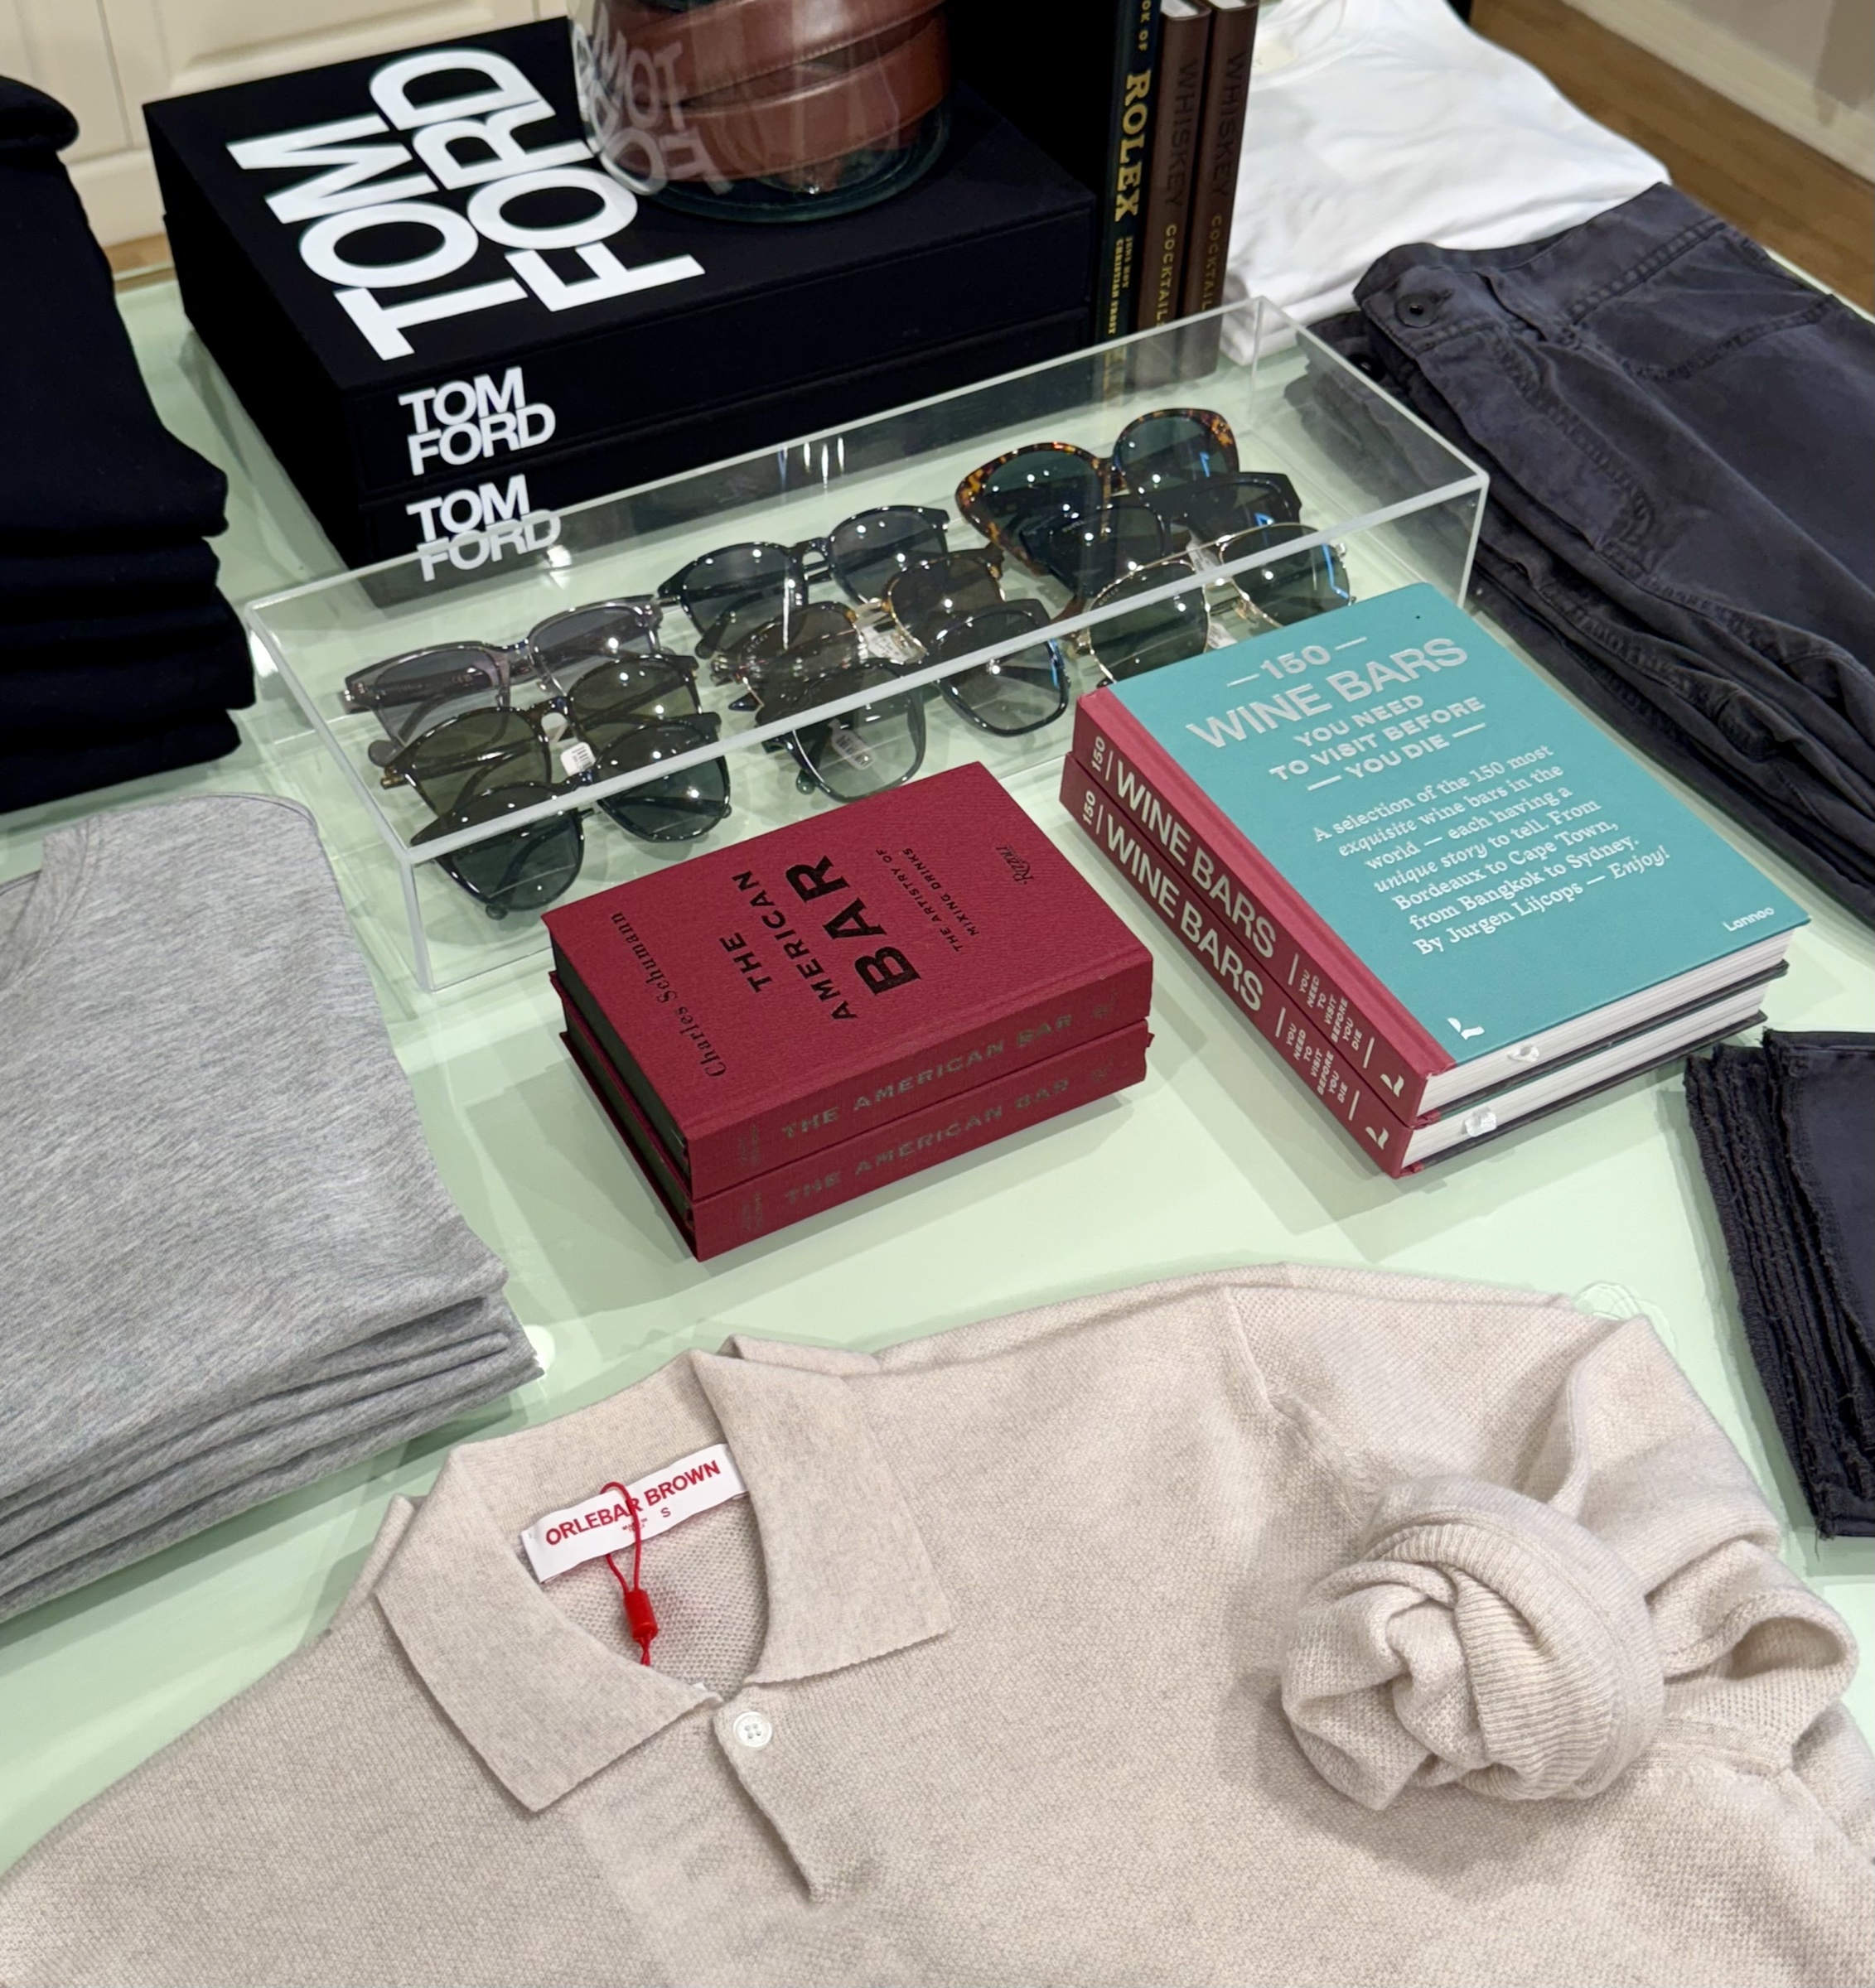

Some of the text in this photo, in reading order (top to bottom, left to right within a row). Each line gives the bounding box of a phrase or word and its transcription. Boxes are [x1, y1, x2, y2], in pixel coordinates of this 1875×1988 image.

[1138, 29, 1148, 51] OF
[1115, 69, 1151, 222] ROLEX
[1212, 51, 1246, 196] WHISKEY
[370, 48, 705, 312] FORD
[1156, 59, 1198, 327] WHISKEY COCKTAIL
[225, 113, 528, 360] TOM
[1112, 238, 1124, 298] CHRISTIAN
[398, 366, 527, 434] TOM
[407, 403, 556, 475] FORD
[406, 474, 530, 542] TOM
[416, 508, 562, 581] FORD
[1185, 638, 1468, 749] WINE BARS
[1259, 644, 1331, 679] 150
[1269, 697, 1486, 780] TO VISIT BEFORE
[1293, 694, 1423, 746] YOU NEED
[1344, 734, 1450, 779] YOU DIE
[1312, 745, 1554, 842] A selection of the 150 most
[1338, 765, 1564, 856] exquisite wine bars in the
[1365, 840, 1422, 870] world
[1447, 815, 1493, 840] each
[1490, 792, 1561, 823] having
[1557, 787, 1573, 799] a
[1090, 736, 1276, 958] 150 WINE BARS
[1374, 800, 1602, 894] unique story to tell. From
[1391, 819, 1618, 911] Bordeaux to Cape Town,
[1409, 832, 1640, 931] from Bangkok to Sydney.
[785, 855, 921, 996] BAR
[876, 848, 964, 953] THE ARTISTRY OF
[902, 847, 979, 936] MIXING DRINKS
[1082, 789, 1263, 1011] 150 WINE BARS
[1412, 934, 1444, 955] By
[1445, 908, 1515, 944] Jurgen
[1510, 881, 1583, 918] Lijcops
[1607, 845, 1670, 880] Enjoy!
[1723, 907, 1775, 932] Lannoo
[718, 932, 773, 993] THE
[732, 871, 858, 1020] AMERICAN
[1298, 969, 1311, 994] YOU
[611, 912, 727, 1077] Charles Schumann
[1307, 976, 1319, 1008] NEED
[1317, 992, 1327, 1009] TO
[1324, 994, 1337, 1025] VISIT
[1331, 997, 1348, 1043] BEFORE
[1286, 1023, 1298, 1046] YOU
[1293, 1029, 1306, 1060] NEED
[1303, 1045, 1312, 1062] TO
[1310, 1048, 1322, 1078] VISIT
[1342, 1018, 1354, 1042] YOU
[1351, 1029, 1363, 1051] DIE
[780, 1013, 1073, 1139] THE AMERICAN BAR
[1317, 1050, 1335, 1095] BEFORE
[1328, 1071, 1340, 1094] YOU
[1337, 1082, 1348, 1103] DIE
[784, 1078, 1070, 1204] THE AMERICAN BAR
[545, 1460, 721, 1546] ORLEBAR BROWN
[660, 1507, 672, 1518] S
